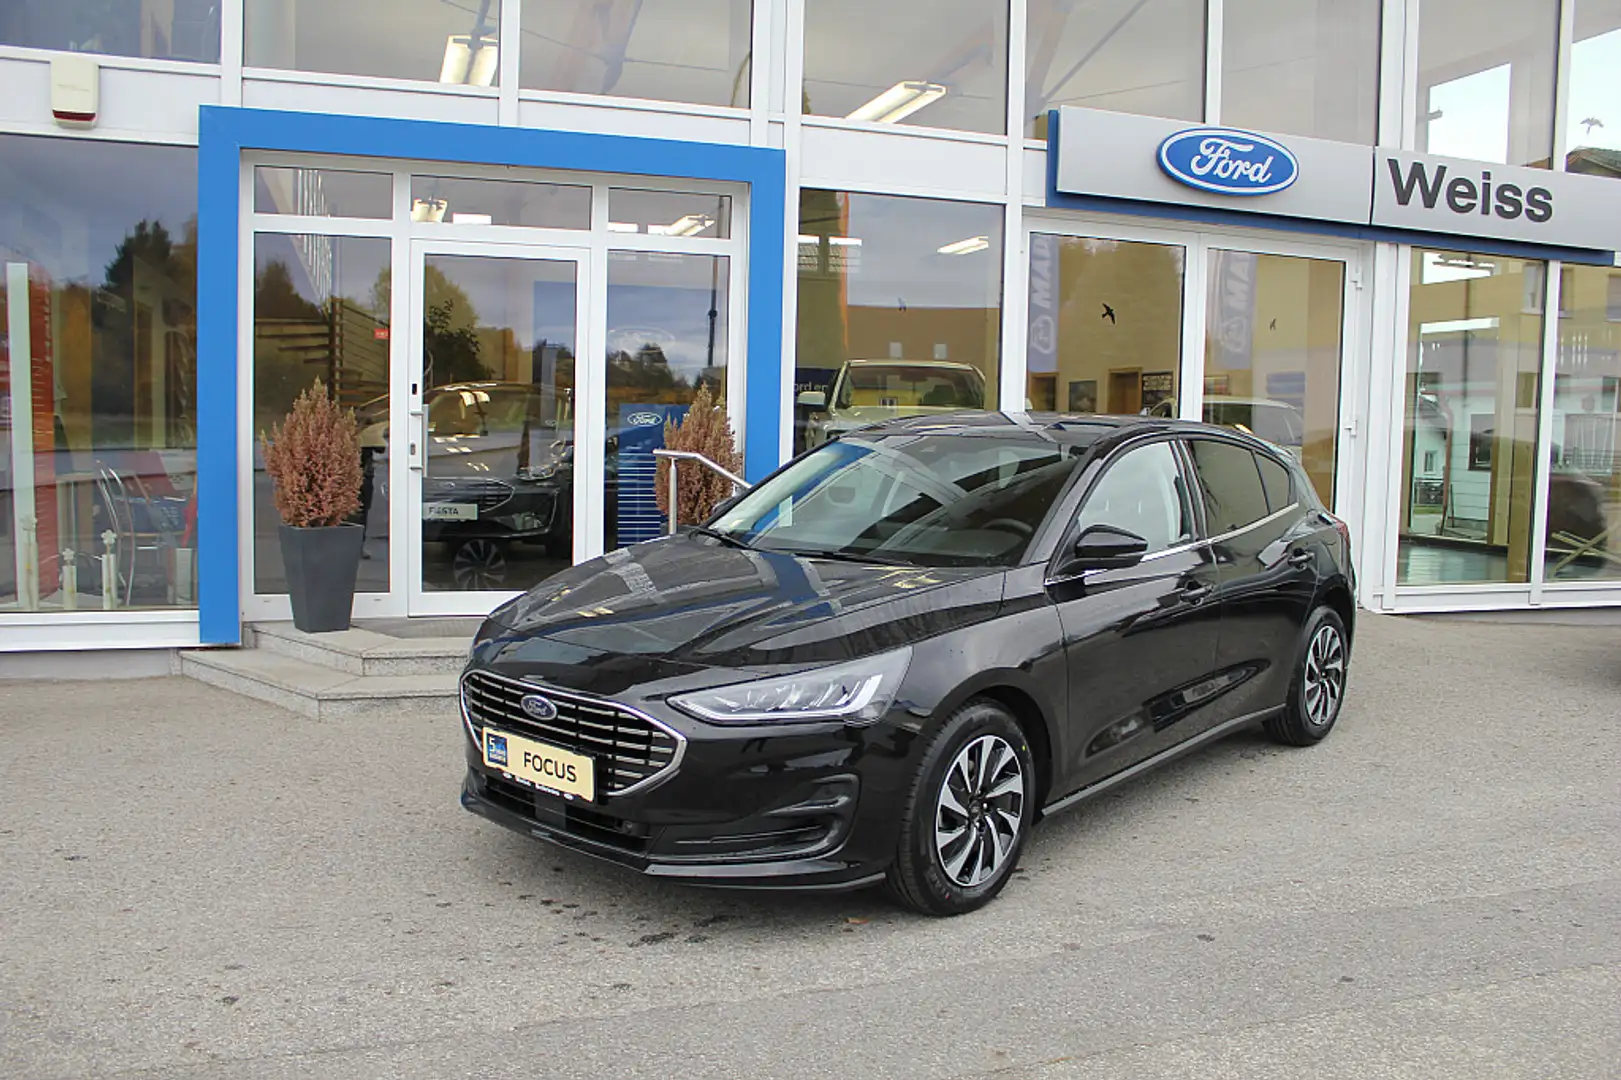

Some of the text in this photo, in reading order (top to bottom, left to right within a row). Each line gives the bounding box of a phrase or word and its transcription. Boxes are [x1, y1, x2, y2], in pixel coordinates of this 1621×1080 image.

[1190, 137, 1274, 183] Ford
[1387, 158, 1553, 223] Weiss
[523, 751, 577, 783] FOCUS
